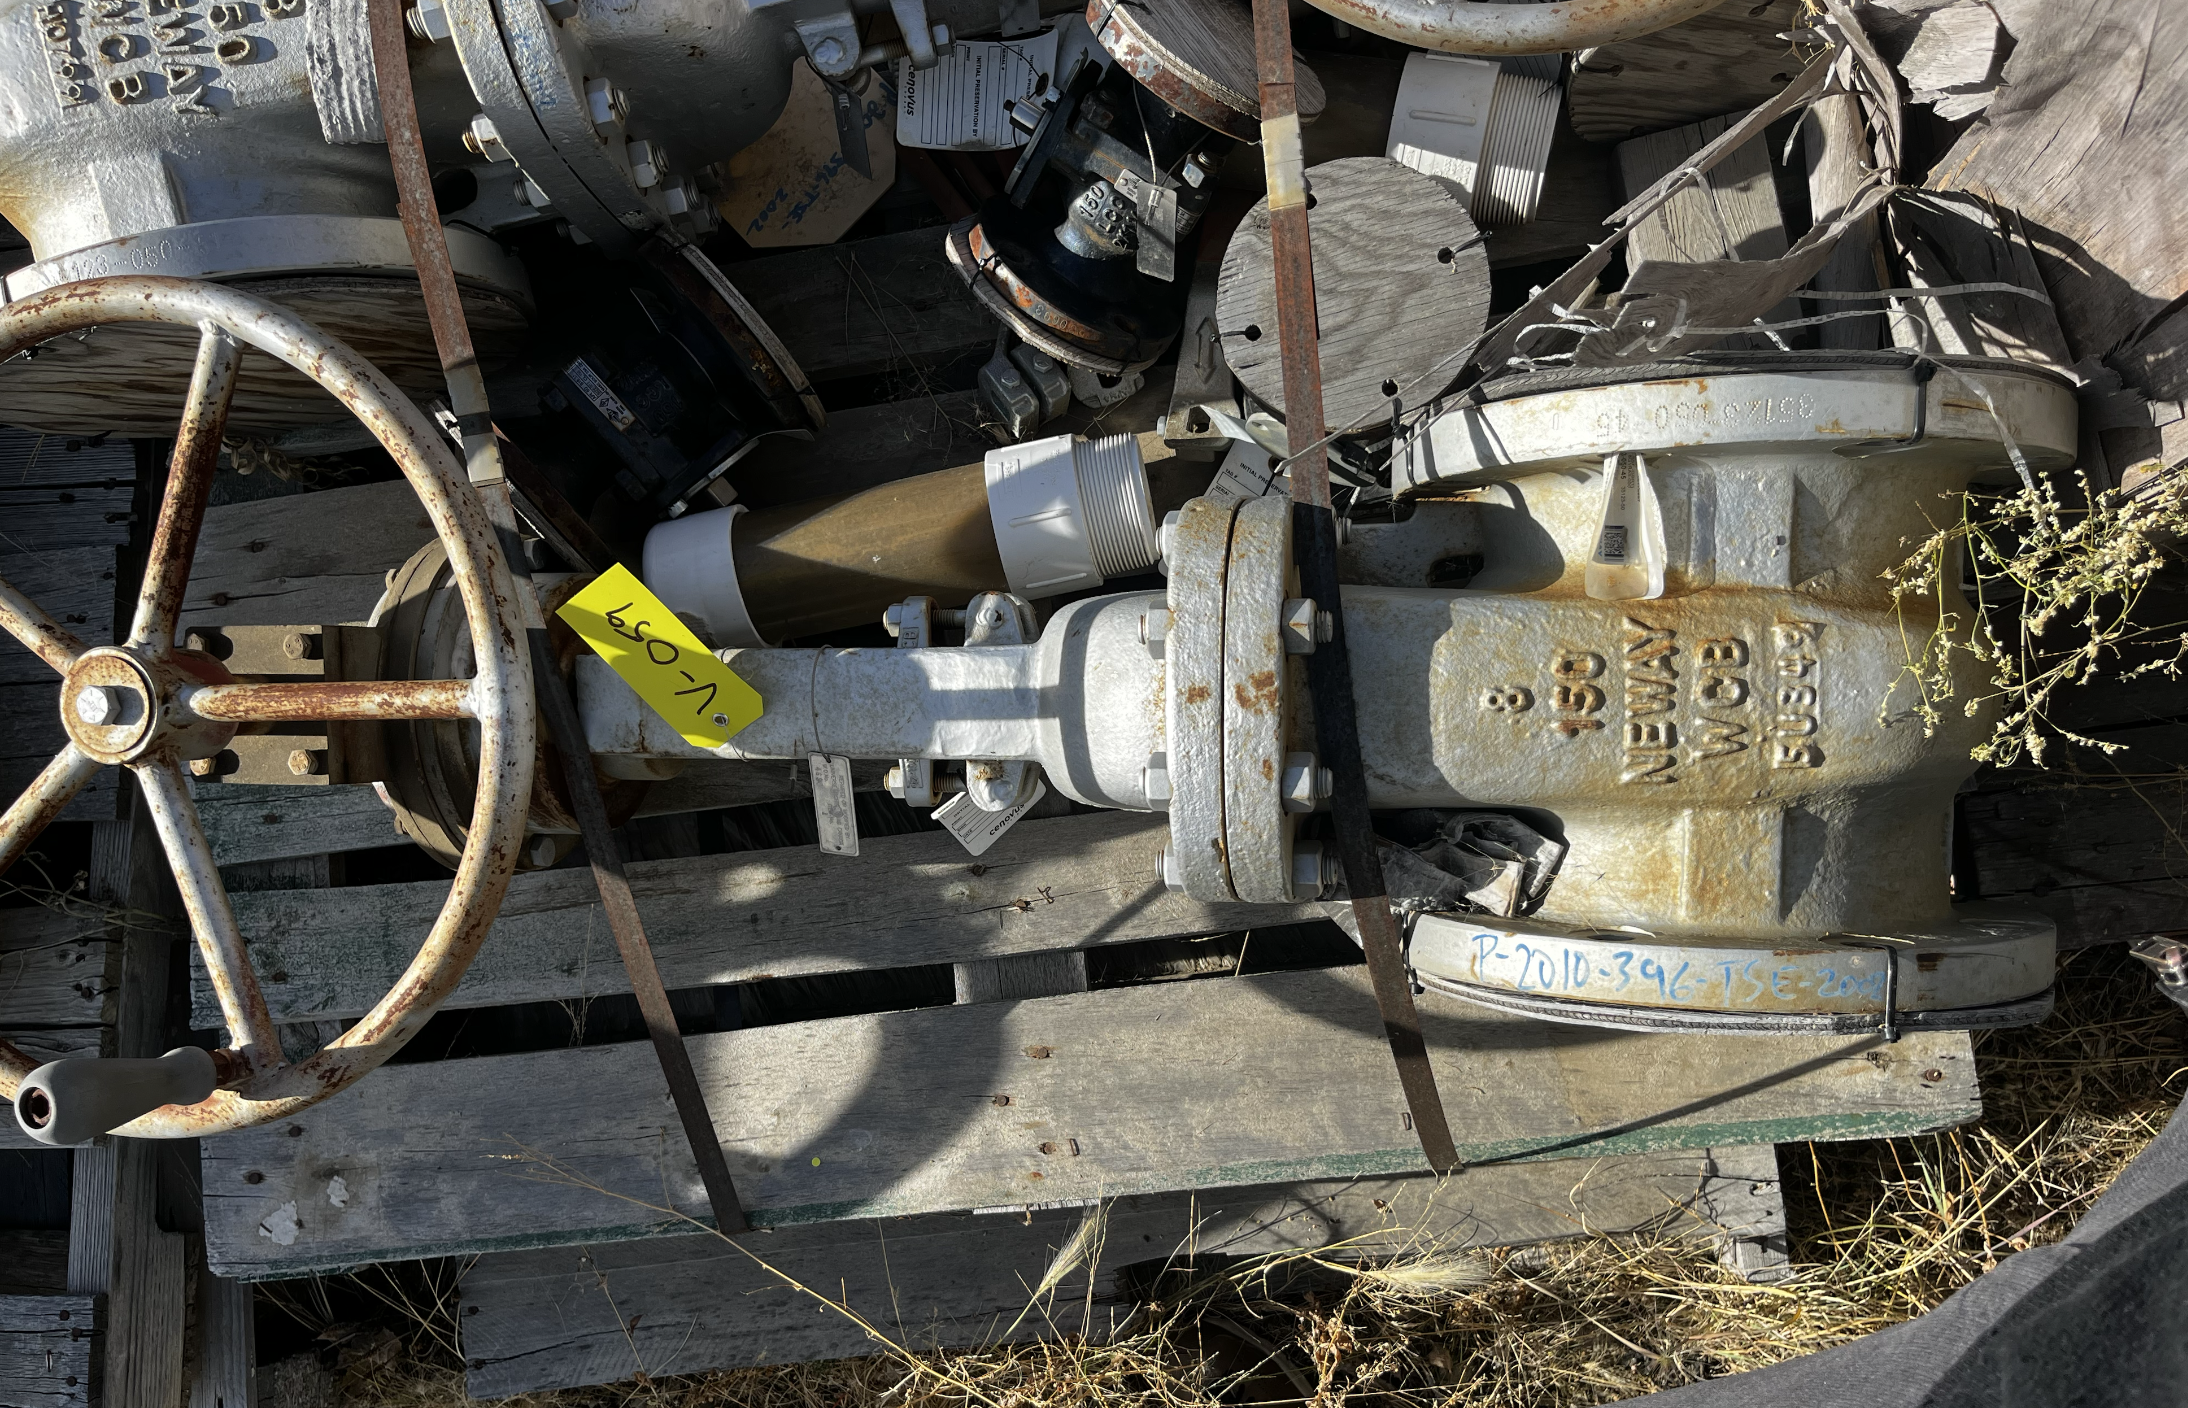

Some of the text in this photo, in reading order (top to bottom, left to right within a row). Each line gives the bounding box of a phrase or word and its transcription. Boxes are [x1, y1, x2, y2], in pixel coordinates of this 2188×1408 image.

[972, 79, 981, 128] PRESERVATION
[1079, 185, 1105, 218] 150
[1240, 462, 1257, 478] INITIAL
[605, 602, 717, 715] V-059
[1479, 685, 1534, 713] 8
[1550, 651, 1605, 738] 150
[1620, 617, 1679, 785] NEWAY
[1691, 638, 1750, 764] WCB
